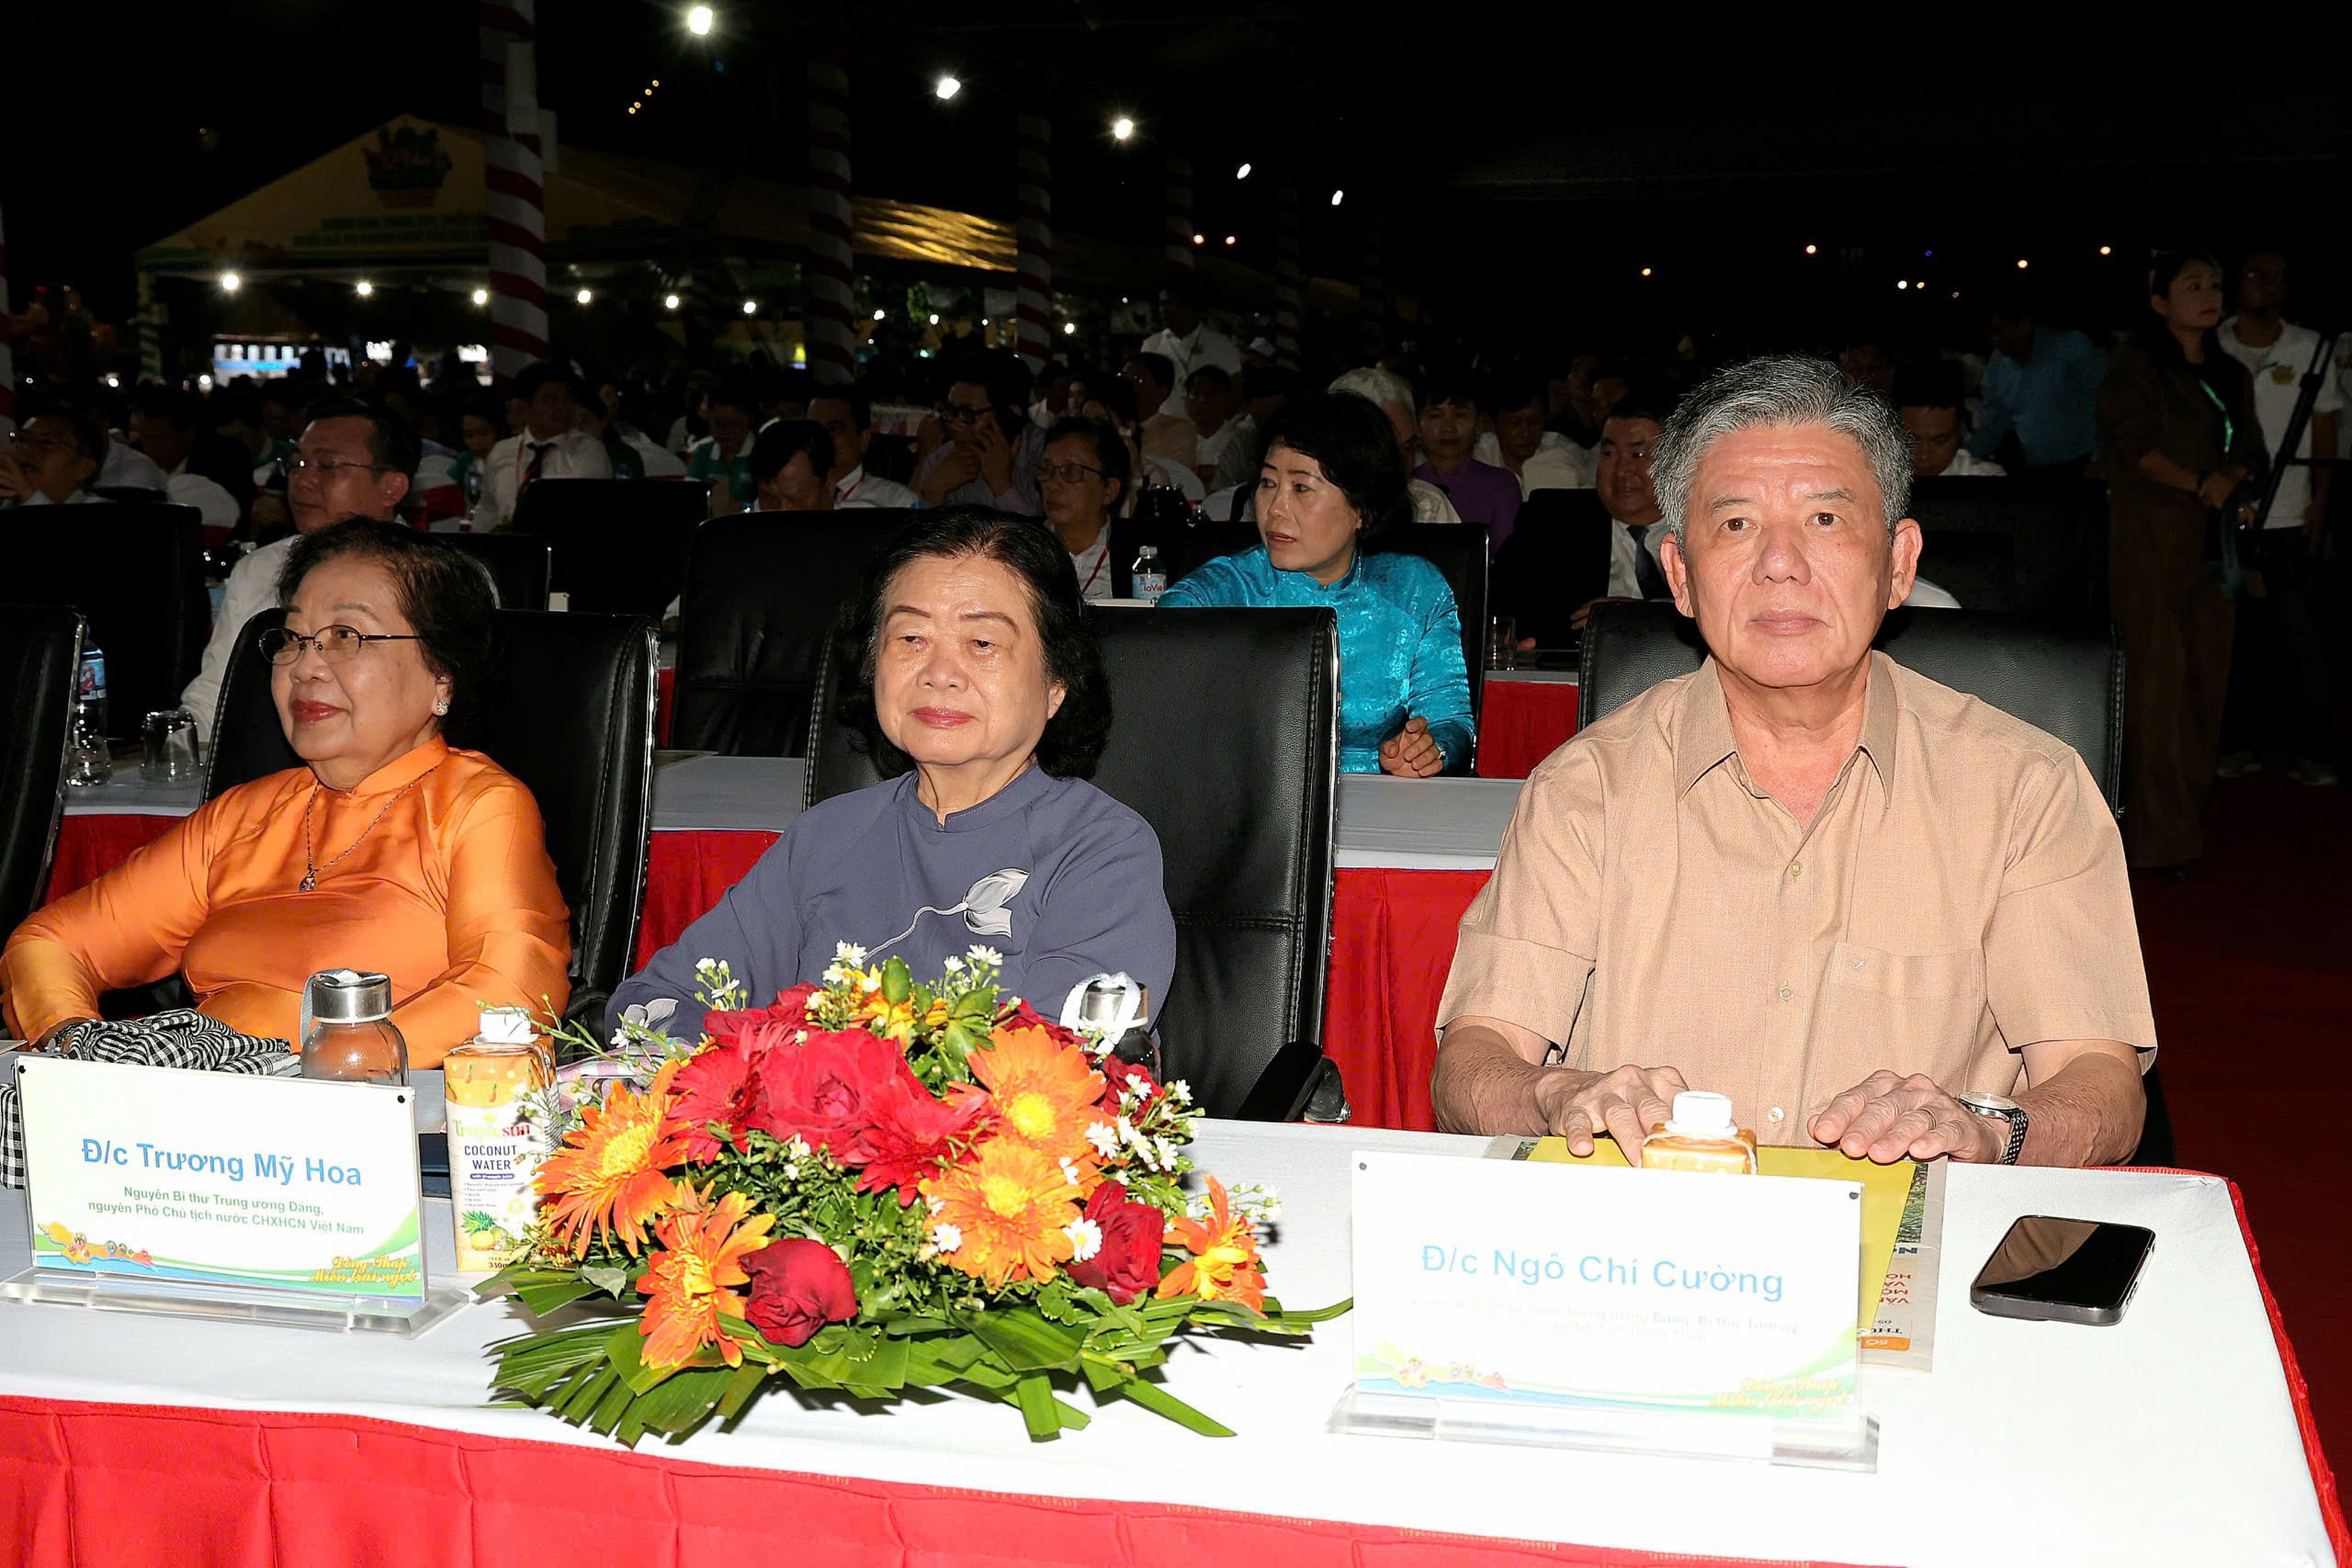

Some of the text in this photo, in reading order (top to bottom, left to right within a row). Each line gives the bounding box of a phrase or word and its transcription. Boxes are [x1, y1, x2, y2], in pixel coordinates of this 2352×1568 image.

[82, 1137, 362, 1186] Đ/c Trương Mỹ Hoa
[464, 1145, 517, 1156] COCONUT
[472, 1159, 511, 1170] WATER
[124, 1186, 169, 1201] Nguyên
[189, 1192, 209, 1204] thư
[213, 1194, 248, 1210] Trung
[252, 1199, 285, 1213] ương
[88, 1201, 131, 1214] nguyên
[190, 1209, 212, 1222] tịch
[252, 1214, 306, 1229] CHXHCN
[310, 1220, 333, 1234] Việt
[336, 1222, 364, 1235] Nam
[1420, 1245, 1783, 1303] Đ/c Ngô Chí Cường
